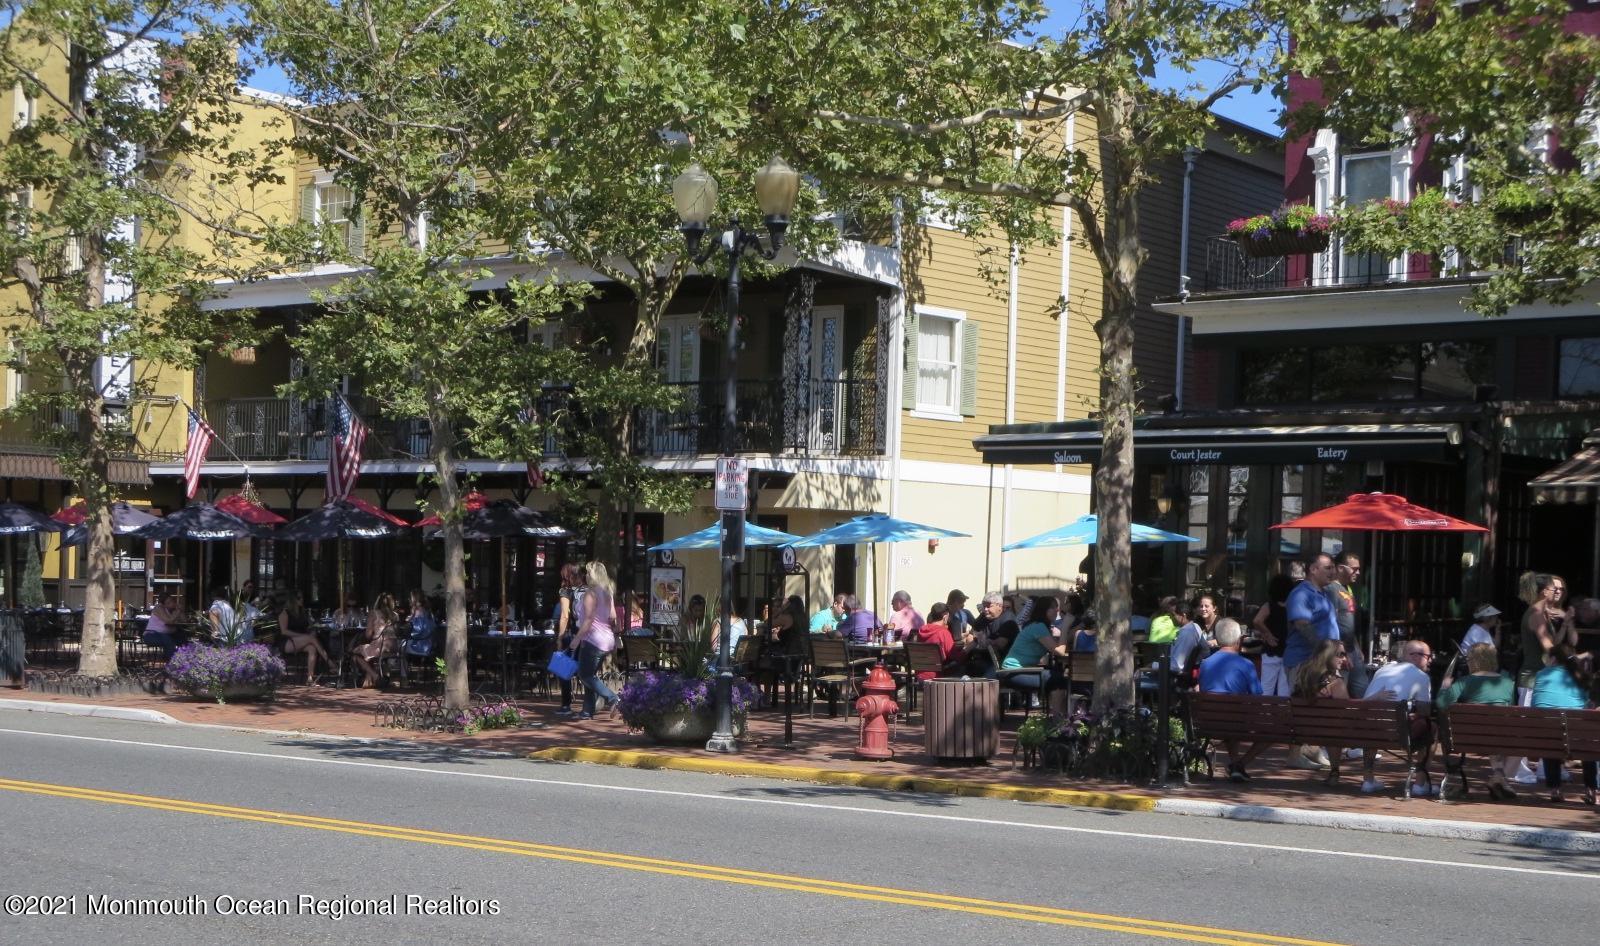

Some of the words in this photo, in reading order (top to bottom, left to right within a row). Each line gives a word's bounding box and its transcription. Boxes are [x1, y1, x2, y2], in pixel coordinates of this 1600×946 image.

[1054, 450, 1082, 462] Saloon
[1170, 449, 1195, 460] Court
[1195, 449, 1222, 462] Jester
[1317, 447, 1348, 461] Eatery
[726, 461, 738, 470] NO
[718, 472, 745, 482] PARKING
[725, 484, 739, 492] THIS
